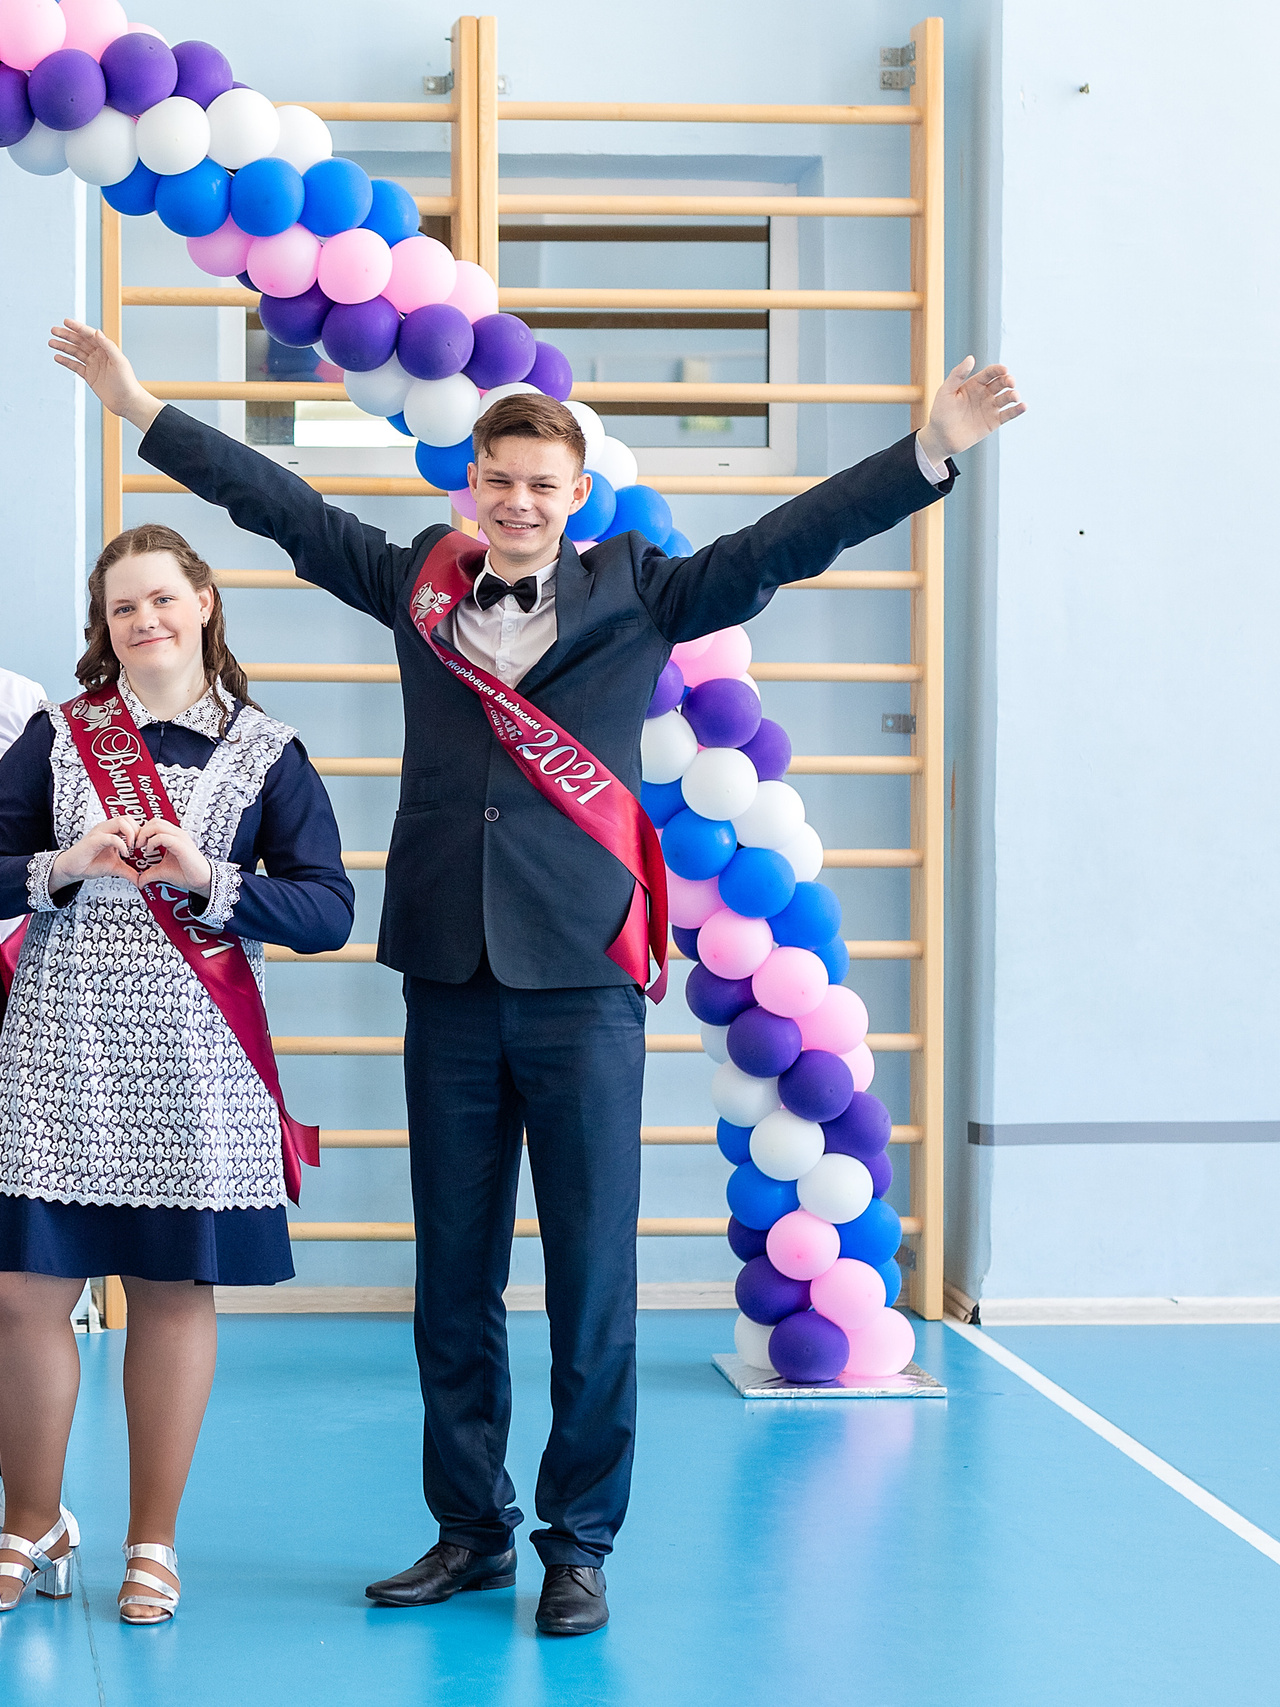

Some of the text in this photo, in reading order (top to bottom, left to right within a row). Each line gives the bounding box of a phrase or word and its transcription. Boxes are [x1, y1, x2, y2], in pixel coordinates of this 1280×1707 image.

[446, 659, 496, 697] Мордовцев
[494, 691, 542, 730] Владислав
[516, 729, 612, 805] 2021
